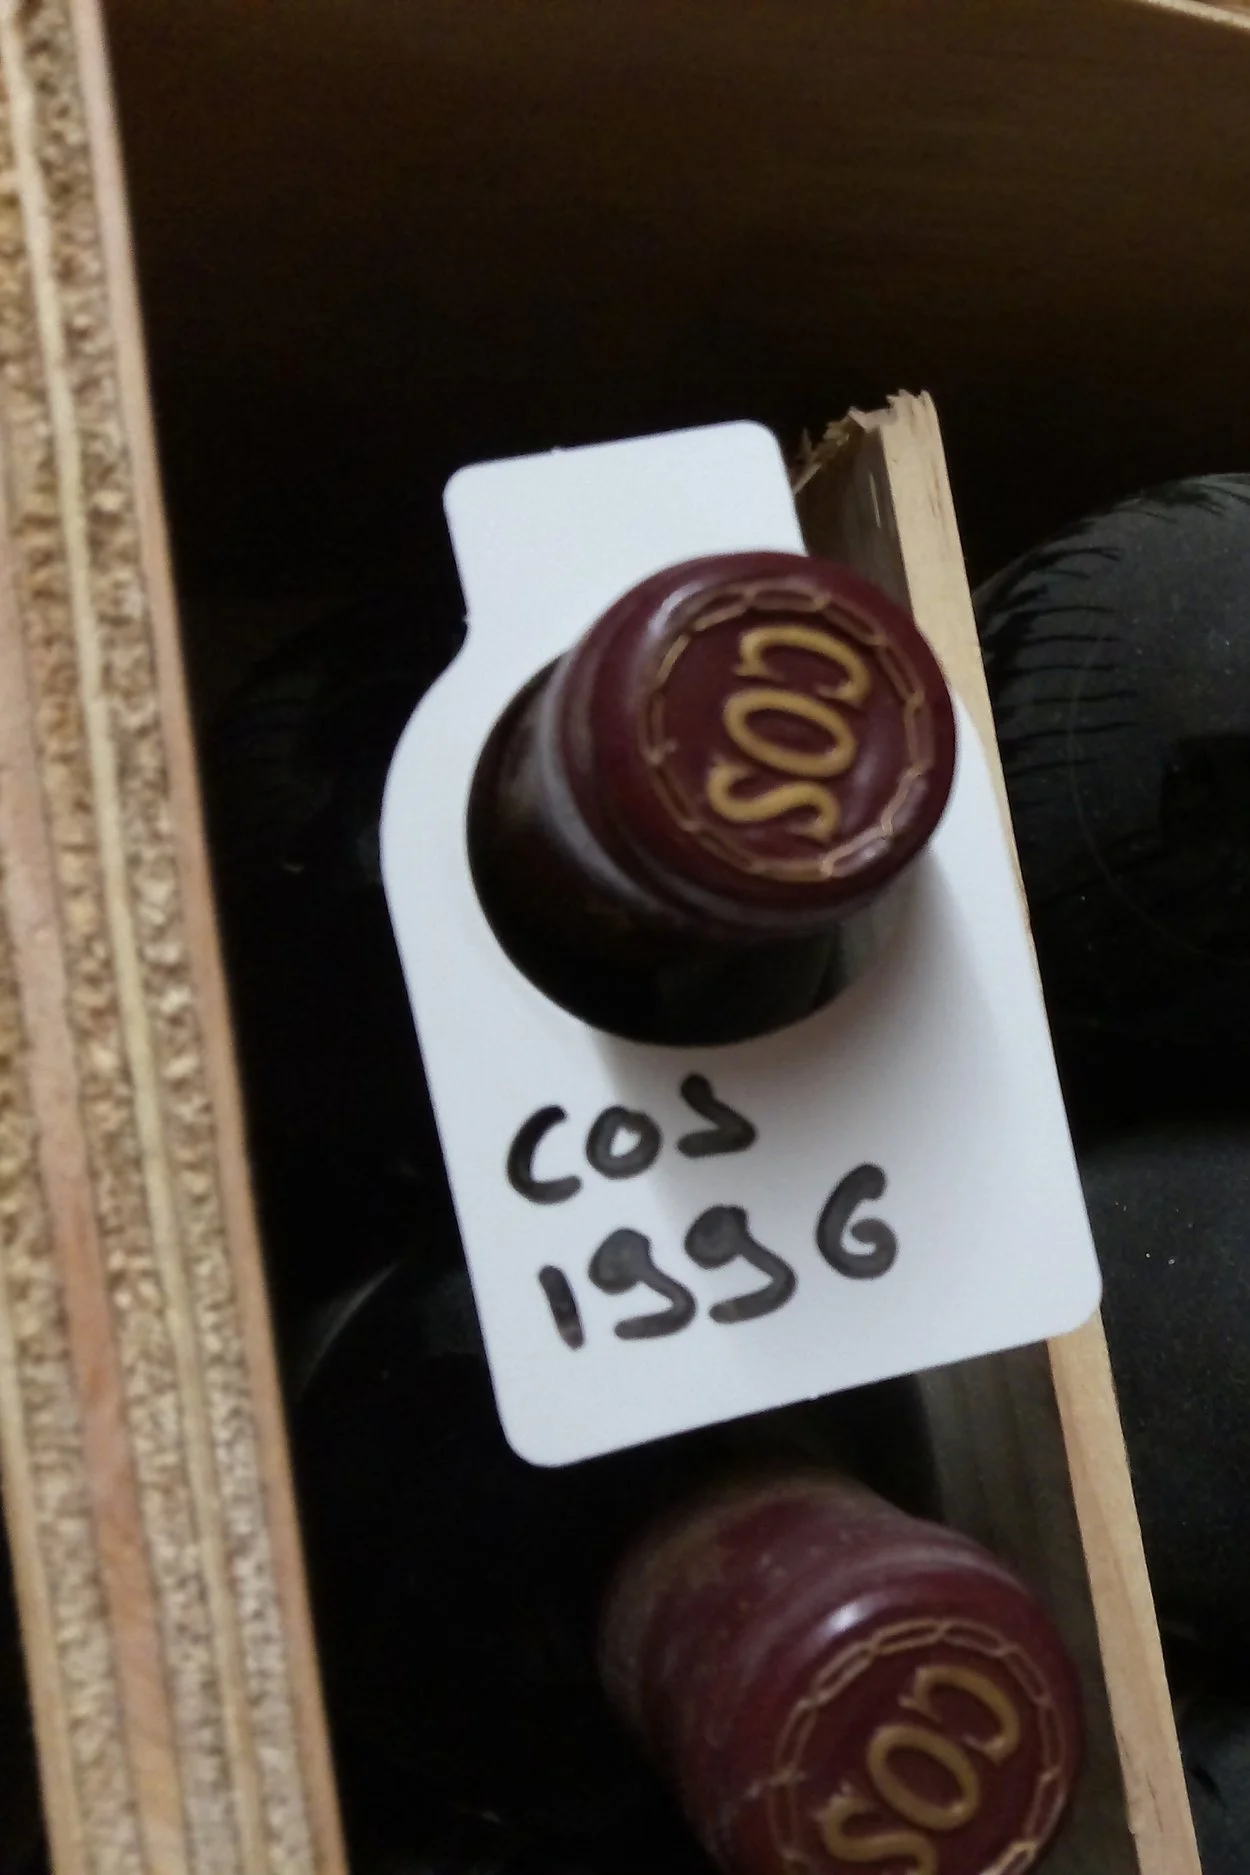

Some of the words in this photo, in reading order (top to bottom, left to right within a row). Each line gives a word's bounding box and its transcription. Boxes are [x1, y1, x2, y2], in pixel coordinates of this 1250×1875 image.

[706, 624, 873, 841] COS
[507, 1073, 758, 1205] COS
[538, 1162, 898, 1350] 1996
[812, 1663, 1021, 1875] COS
